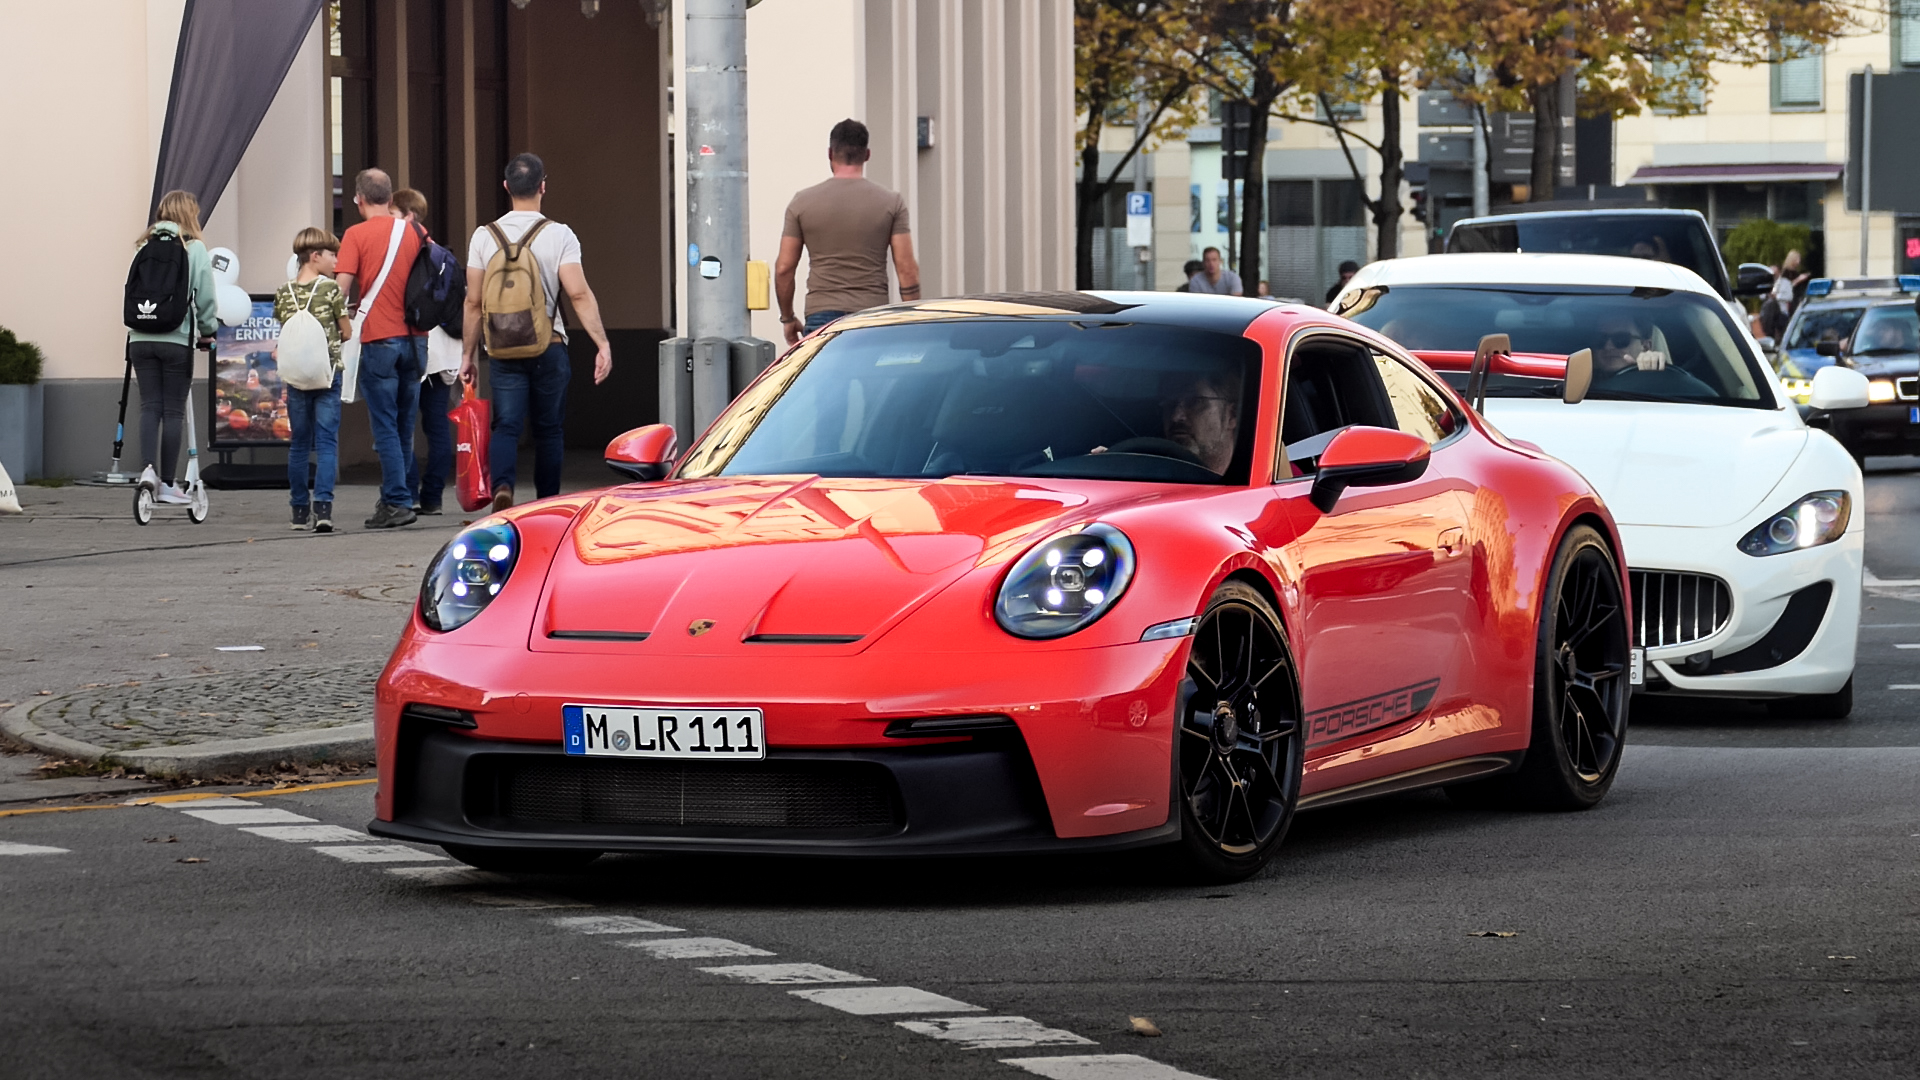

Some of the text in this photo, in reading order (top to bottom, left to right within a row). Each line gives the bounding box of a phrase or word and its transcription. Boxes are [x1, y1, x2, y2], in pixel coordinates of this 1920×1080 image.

[586, 713, 759, 753] M LR 111
[1312, 694, 1409, 739] PORSCHE
[571, 734, 580, 746] D
